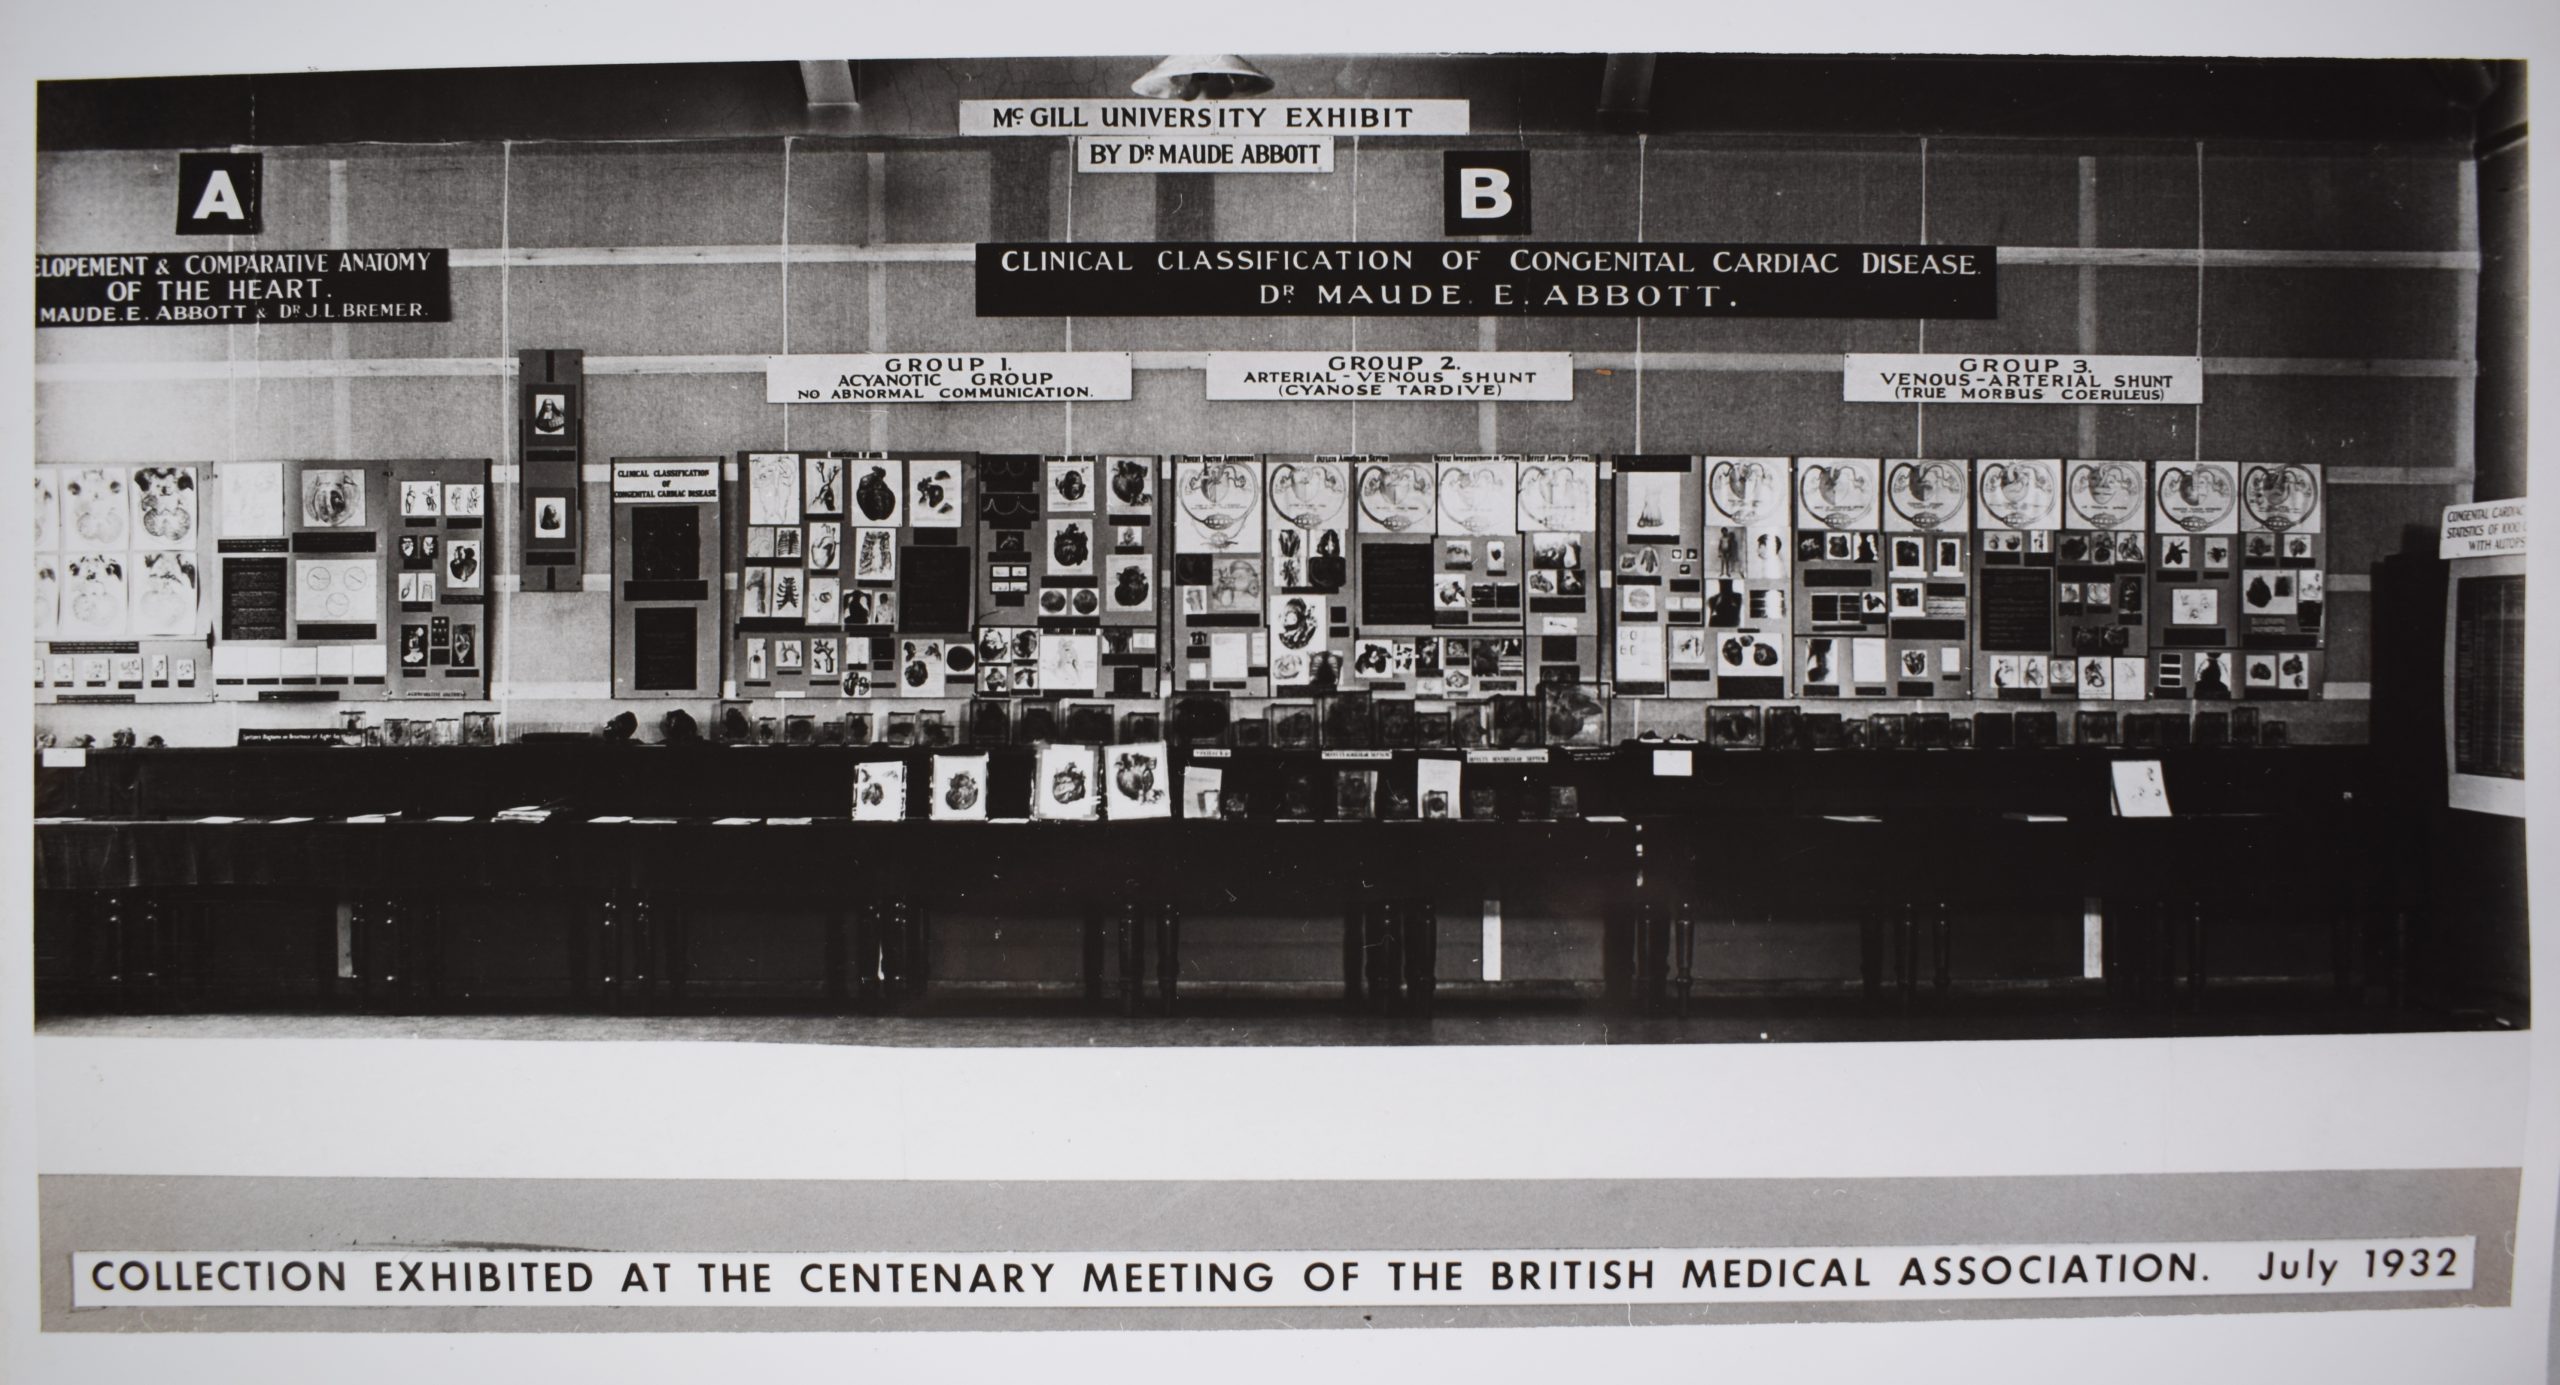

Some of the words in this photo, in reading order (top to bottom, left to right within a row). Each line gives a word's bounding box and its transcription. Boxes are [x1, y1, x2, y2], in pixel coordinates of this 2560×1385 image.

[1102, 107, 1266, 127] UNIVERSITY
[1287, 108, 1412, 127] EXHIBIT
[1091, 144, 1122, 164] BY
[1160, 144, 1233, 164] MAUDE
[1241, 144, 1320, 164] ABBOTT
[193, 170, 244, 219] A
[1461, 168, 1512, 218] B
[156, 259, 169, 275] &
[184, 254, 328, 275] COMPARATIVE
[339, 253, 430, 273] ANATOMY
[1002, 251, 1132, 271] CLINICAL
[1158, 251, 1411, 270] CLASSIFICATION
[1443, 251, 1480, 270] OF
[1511, 250, 1694, 272] CONGENITAL
[1713, 252, 1838, 273] CARDIAC
[108, 281, 141, 301] OF
[158, 281, 209, 300] THE
[229, 279, 331, 299] HEART.
[1544, 285, 1736, 306] ABBOTT.
[156, 305, 246, 320] ABBOTT
[256, 308, 265, 319] &
[886, 358, 984, 372] GROUP
[1329, 356, 1422, 370] GROUP
[1441, 356, 1460, 370] 2.
[1960, 358, 2058, 372] GROUP
[2074, 360, 2092, 373] 3.
[838, 374, 941, 387] ACYANOTIC
[972, 373, 1053, 385] GROUP
[1463, 372, 1536, 383] SHUNT
[2115, 375, 2173, 388] SHUNT
[798, 390, 820, 399] NO
[832, 389, 924, 399] ABNORMAL
[940, 387, 1093, 398] COMMUNICATION.
[1278, 384, 1381, 397] (CYANOSE
[1397, 384, 1501, 397] TARDIVE)
[1895, 386, 1946, 399] (TRUE
[1962, 388, 2043, 399] MORBUS
[2062, 388, 2164, 401] COERULEUS)
[2488, 524, 2500, 535] OF
[2468, 539, 2491, 551] WITH
